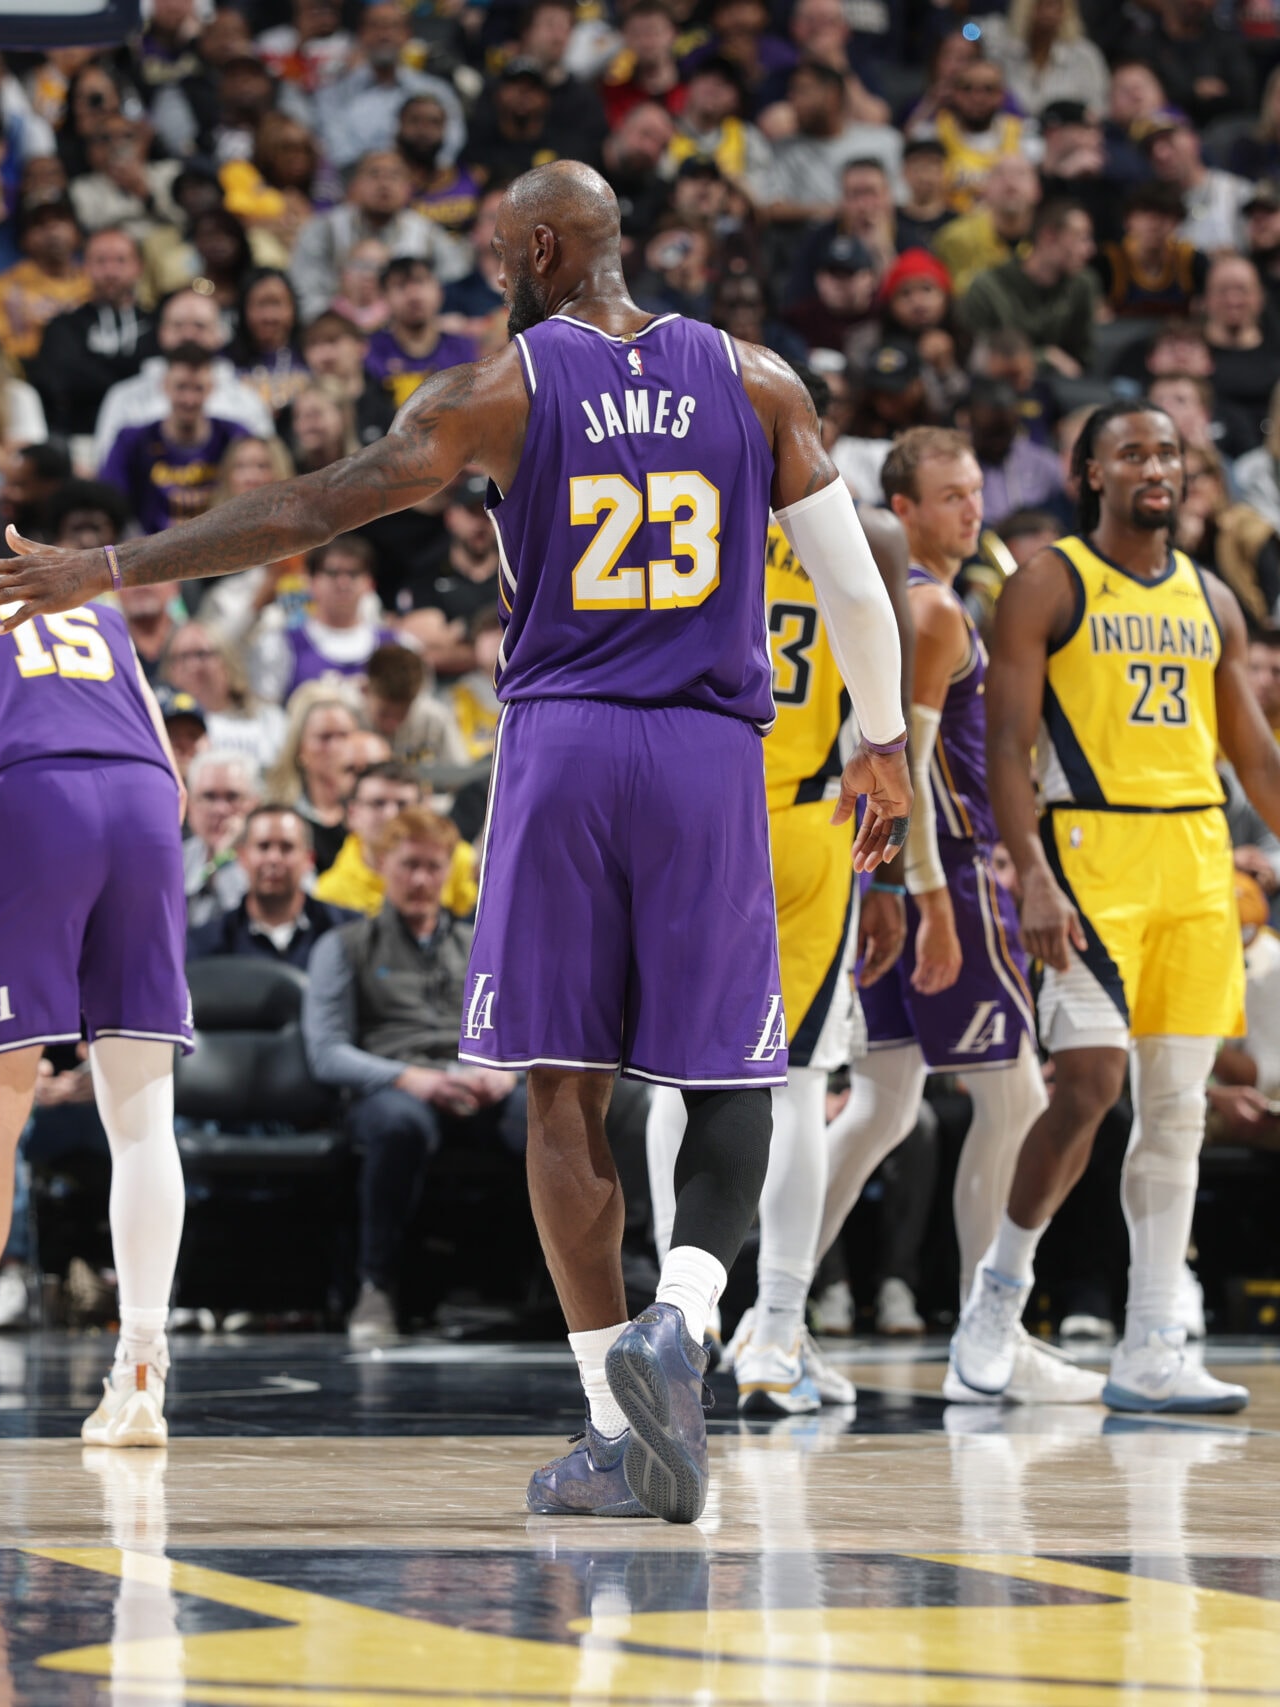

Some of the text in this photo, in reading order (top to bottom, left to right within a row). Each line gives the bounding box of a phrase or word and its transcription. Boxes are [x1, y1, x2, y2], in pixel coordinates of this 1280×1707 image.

[581, 389, 696, 443] JAMES
[569, 470, 720, 610] 23
[1089, 613, 1216, 662] INDIANA
[1128, 662, 1189, 725] 23
